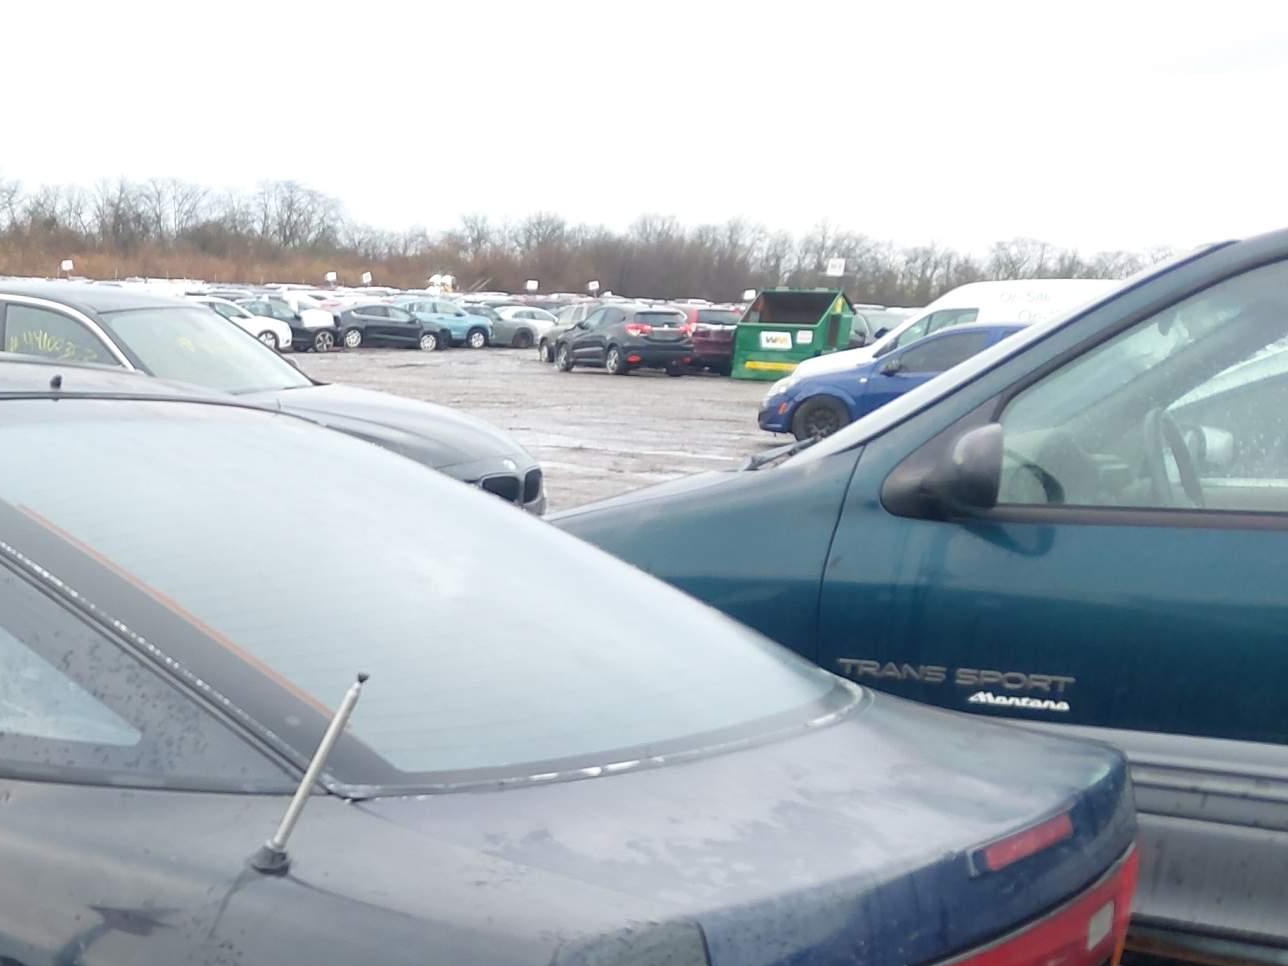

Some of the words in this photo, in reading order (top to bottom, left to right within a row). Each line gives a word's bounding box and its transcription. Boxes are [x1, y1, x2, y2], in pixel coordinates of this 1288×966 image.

[838, 657, 947, 682] TRANS
[955, 667, 1076, 692] SPORT
[968, 690, 1070, 711] Montana
